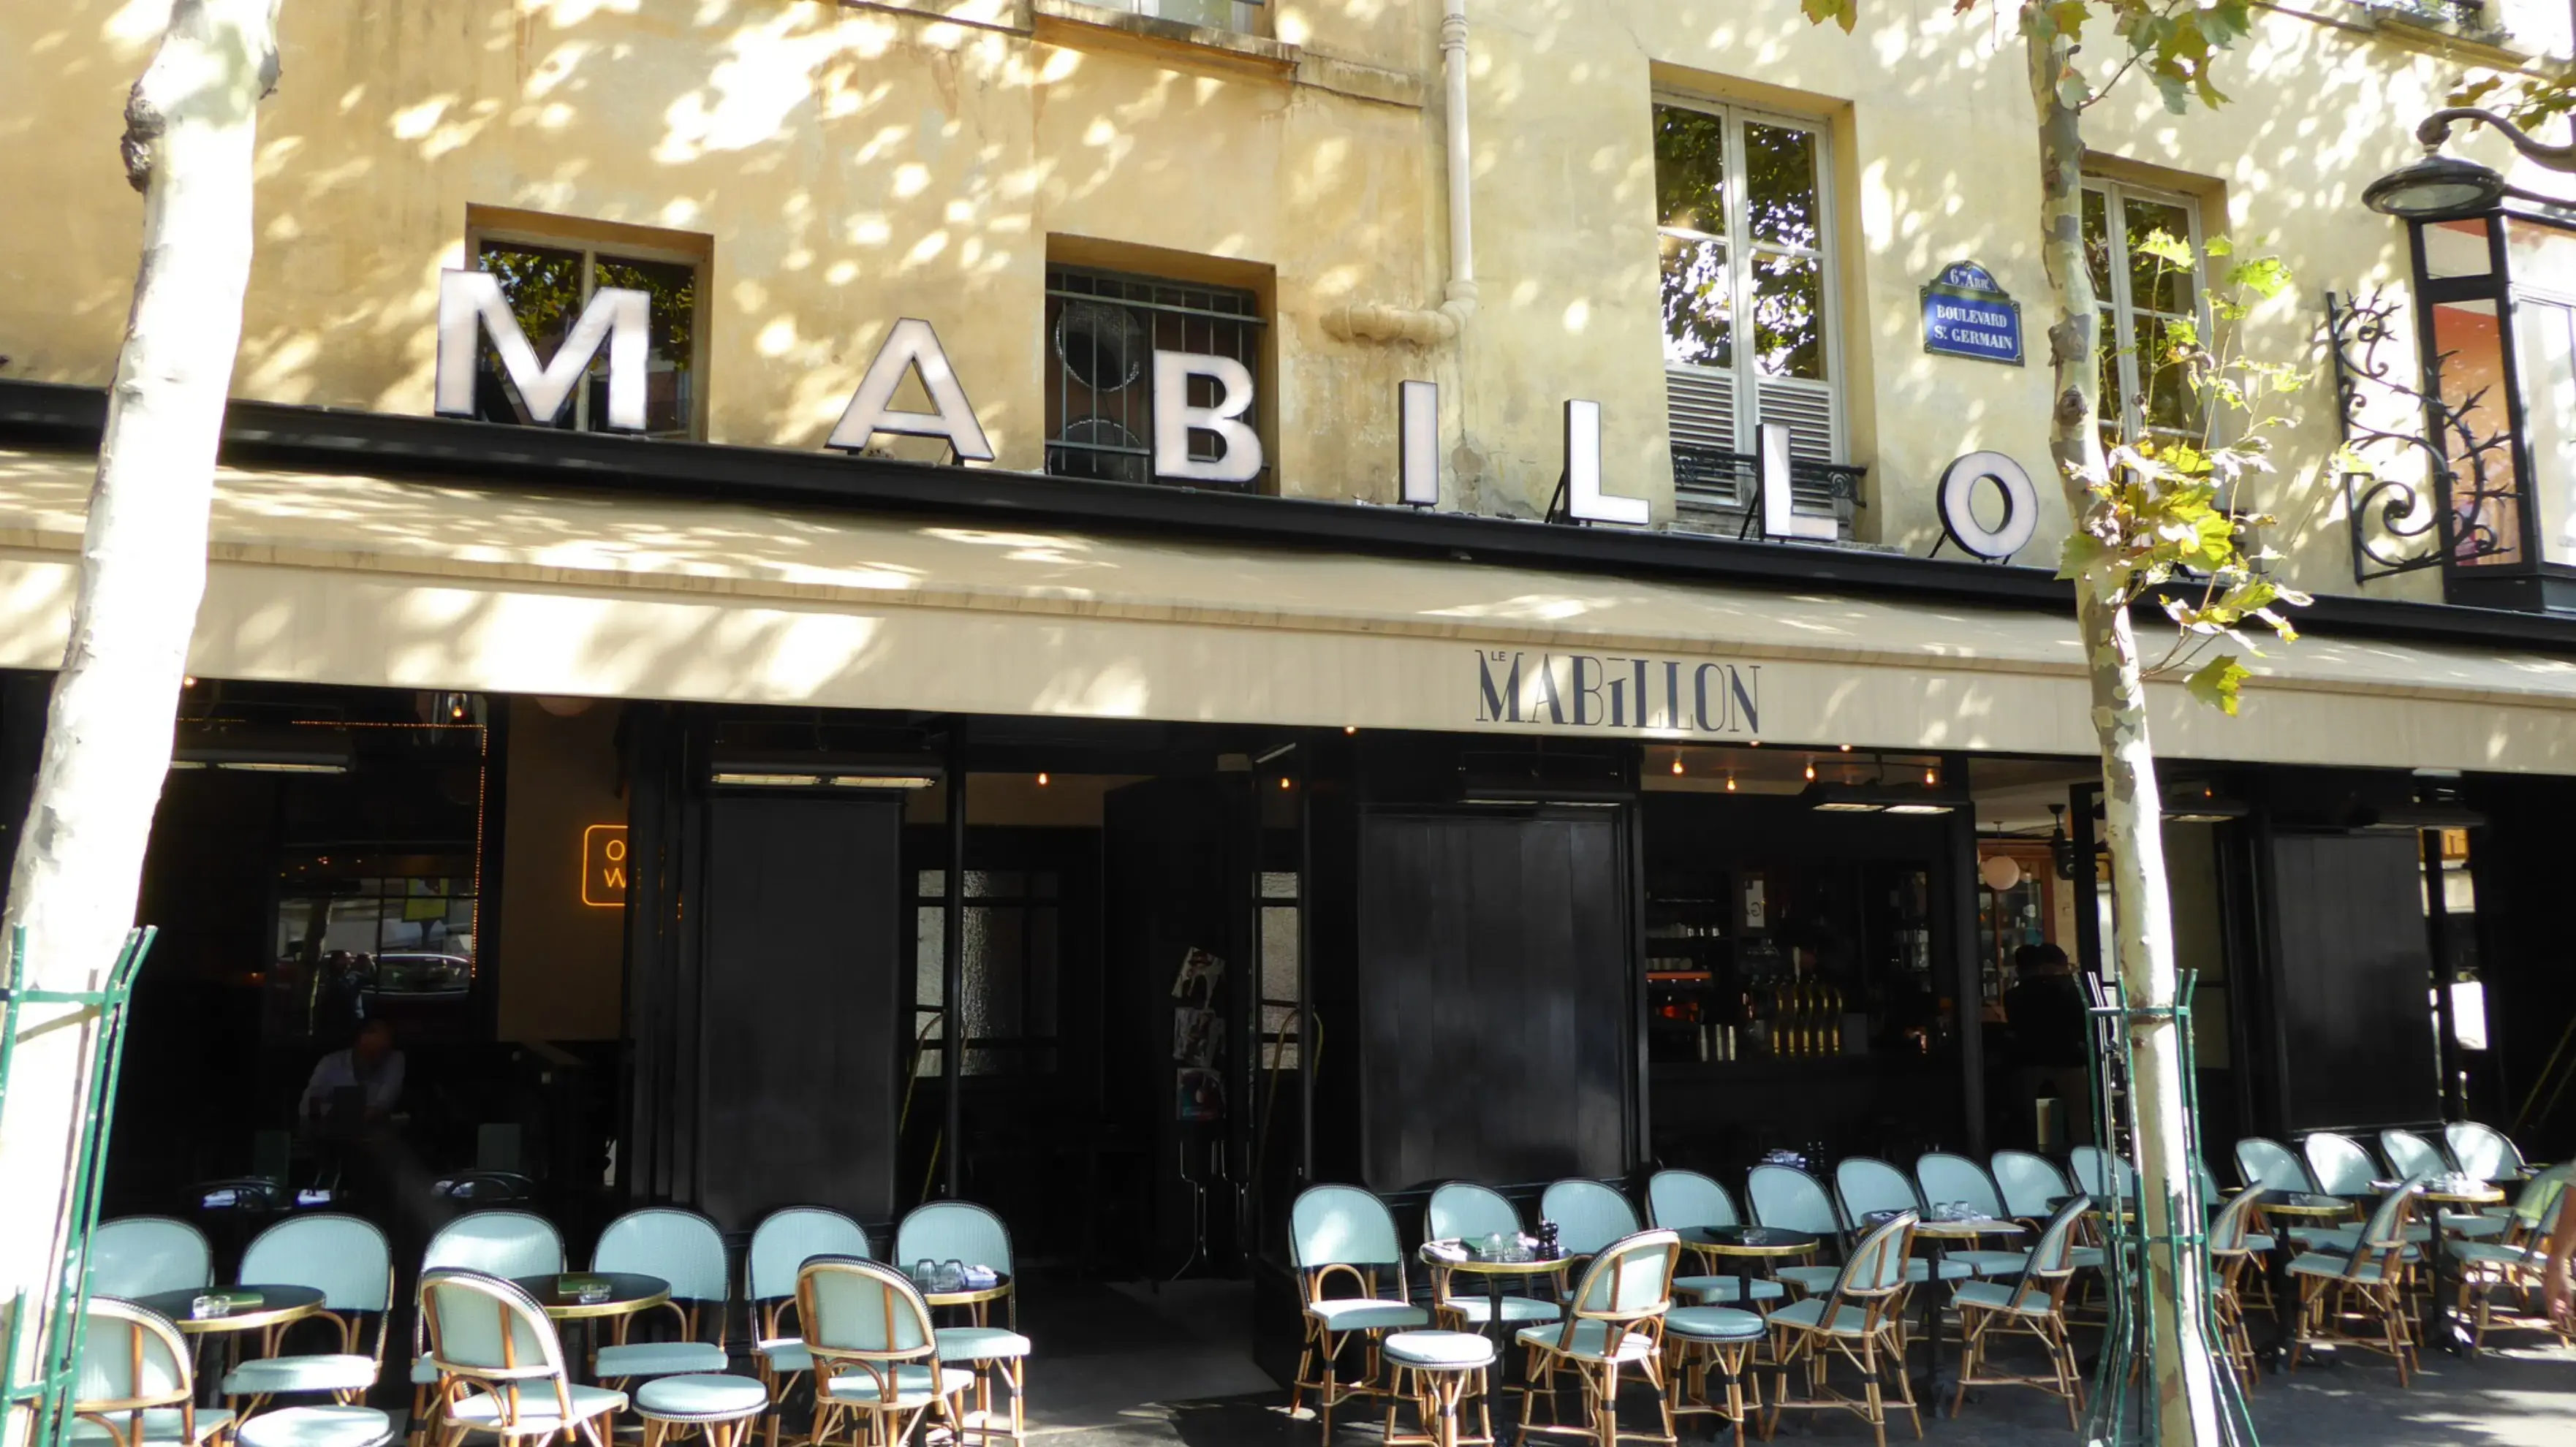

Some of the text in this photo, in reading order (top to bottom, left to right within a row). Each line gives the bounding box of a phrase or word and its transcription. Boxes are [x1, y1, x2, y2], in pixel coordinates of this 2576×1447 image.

[1936, 305, 2007, 328] BOULEVARD
[1951, 328, 2012, 350] GERMAIN
[435, 267, 2213, 571] MABILLO
[1491, 650, 1507, 662] LE
[1474, 649, 1761, 734] MABILLON
